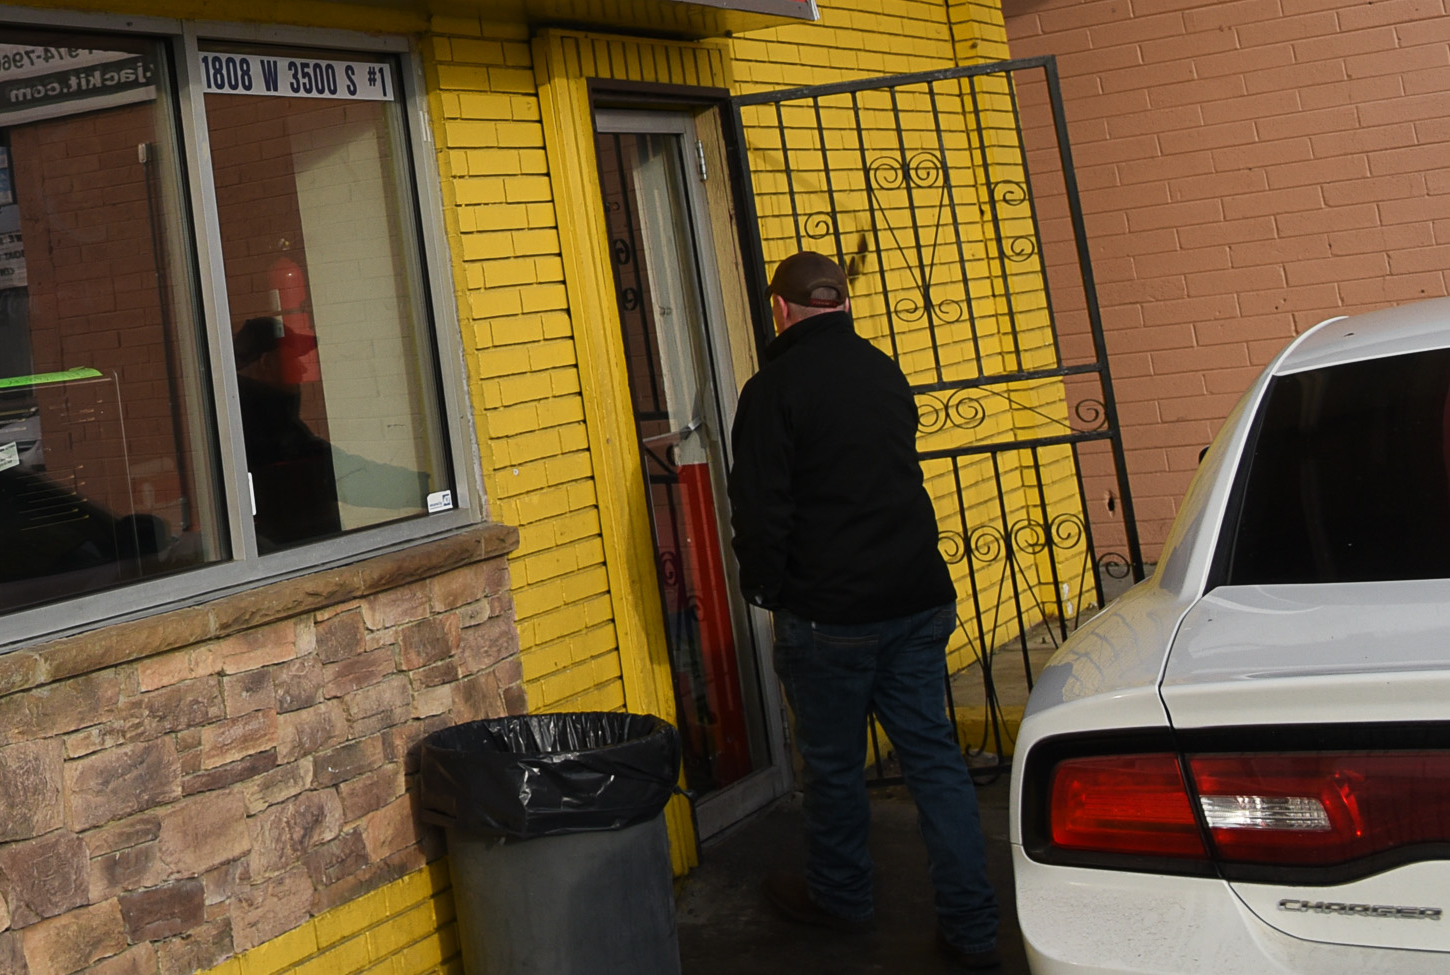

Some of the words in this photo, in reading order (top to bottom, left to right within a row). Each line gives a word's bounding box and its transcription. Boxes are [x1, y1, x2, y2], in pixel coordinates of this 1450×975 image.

[202, 55, 253, 91] 1808
[260, 59, 279, 92] W
[287, 60, 338, 96] 3500
[345, 64, 357, 96] S
[368, 66, 387, 97] #1
[1277, 898, 1442, 921] CHARGER
